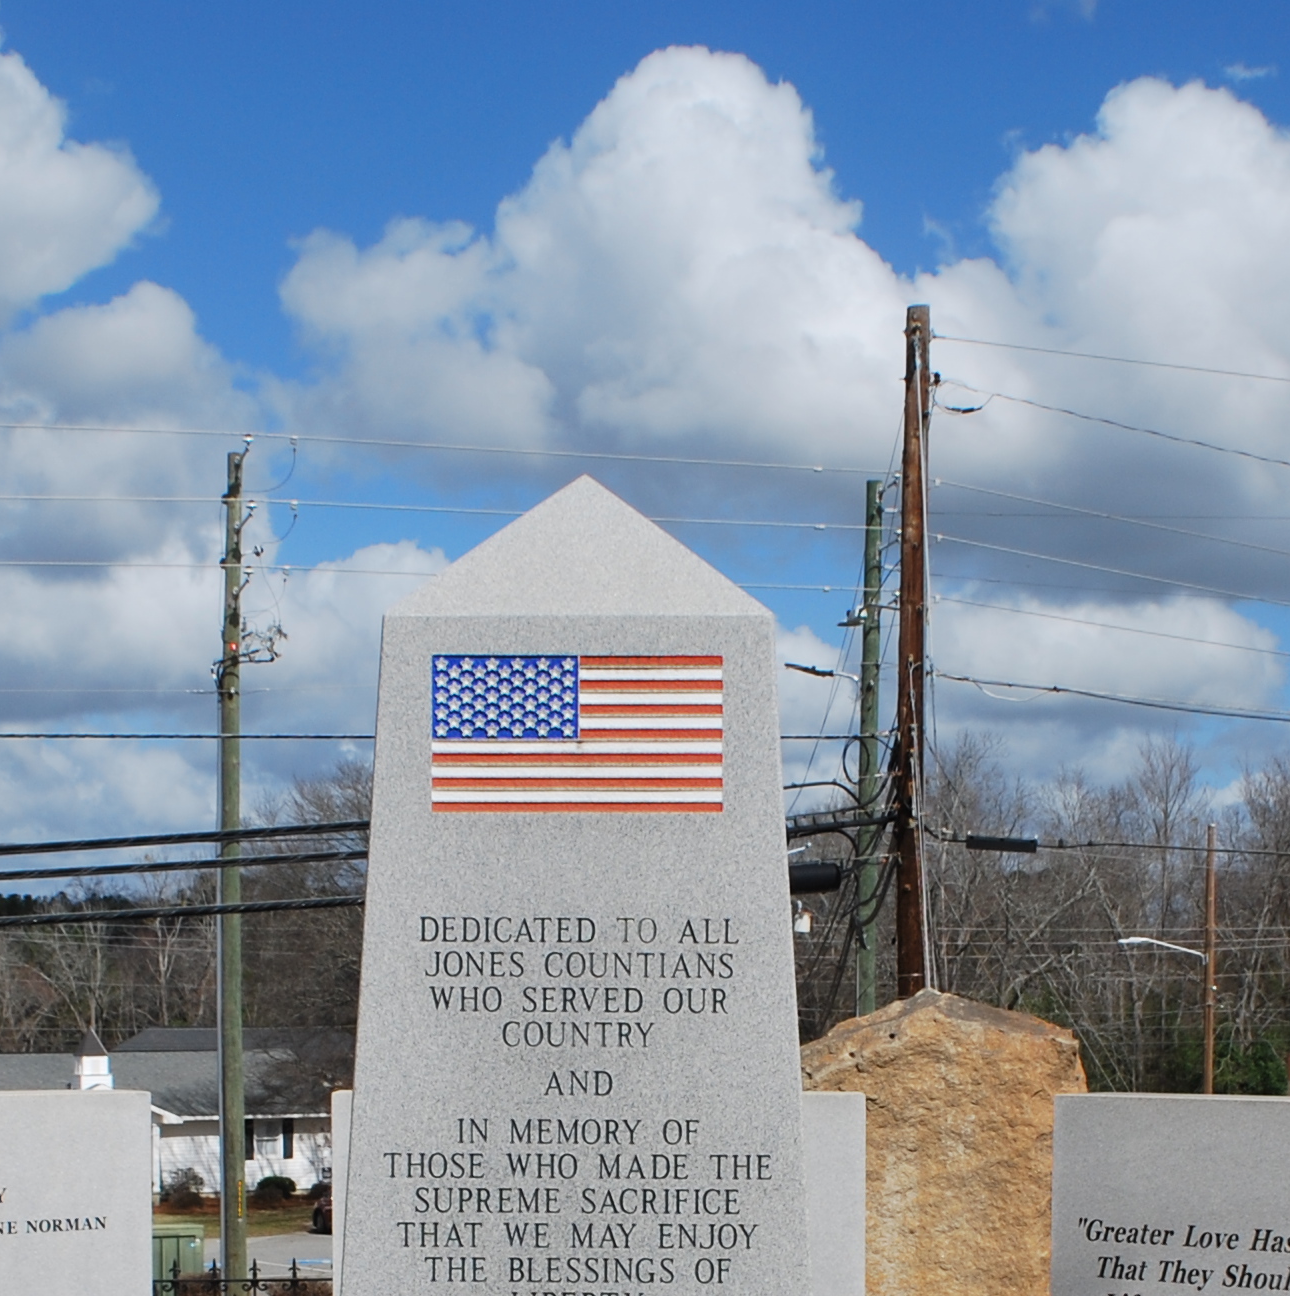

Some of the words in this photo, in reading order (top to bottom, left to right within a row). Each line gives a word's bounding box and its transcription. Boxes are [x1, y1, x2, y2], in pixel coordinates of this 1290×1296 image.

[421, 917, 595, 943] DEDICATED
[617, 918, 657, 943] TO
[679, 919, 739, 944] ALL
[425, 951, 524, 977] JONES
[544, 952, 733, 979] COUNTIANS
[430, 986, 502, 1012] WHO
[523, 987, 643, 1013] SERVED
[664, 988, 726, 1014] OUR
[502, 1021, 654, 1047] COUNTRY
[544, 1071, 613, 1096] AND
[458, 1118, 488, 1143] IN
[511, 1119, 641, 1145] MEMORY
[663, 1119, 699, 1145] OF
[383, 1152, 484, 1179] THOSE
[506, 1153, 577, 1179] WHO
[599, 1154, 688, 1180] MADE
[710, 1154, 771, 1180] THE
[415, 1187, 560, 1213] SUPREME
[581, 1188, 739, 1214] SACRIFICE
[26, 1216, 106, 1234] NORMAN
[397, 1222, 482, 1247] THAT
[504, 1222, 550, 1248] WE
[571, 1223, 636, 1248] MAY
[659, 1223, 757, 1249] ENJOY
[1078, 1217, 1175, 1246] "Greater
[1183, 1225, 1239, 1250] Love
[425, 1257, 487, 1282] THE
[509, 1257, 674, 1283] BLESSINGS
[695, 1258, 731, 1284] OF
[1097, 1255, 1147, 1281] That
[1158, 1260, 1214, 1291] They
